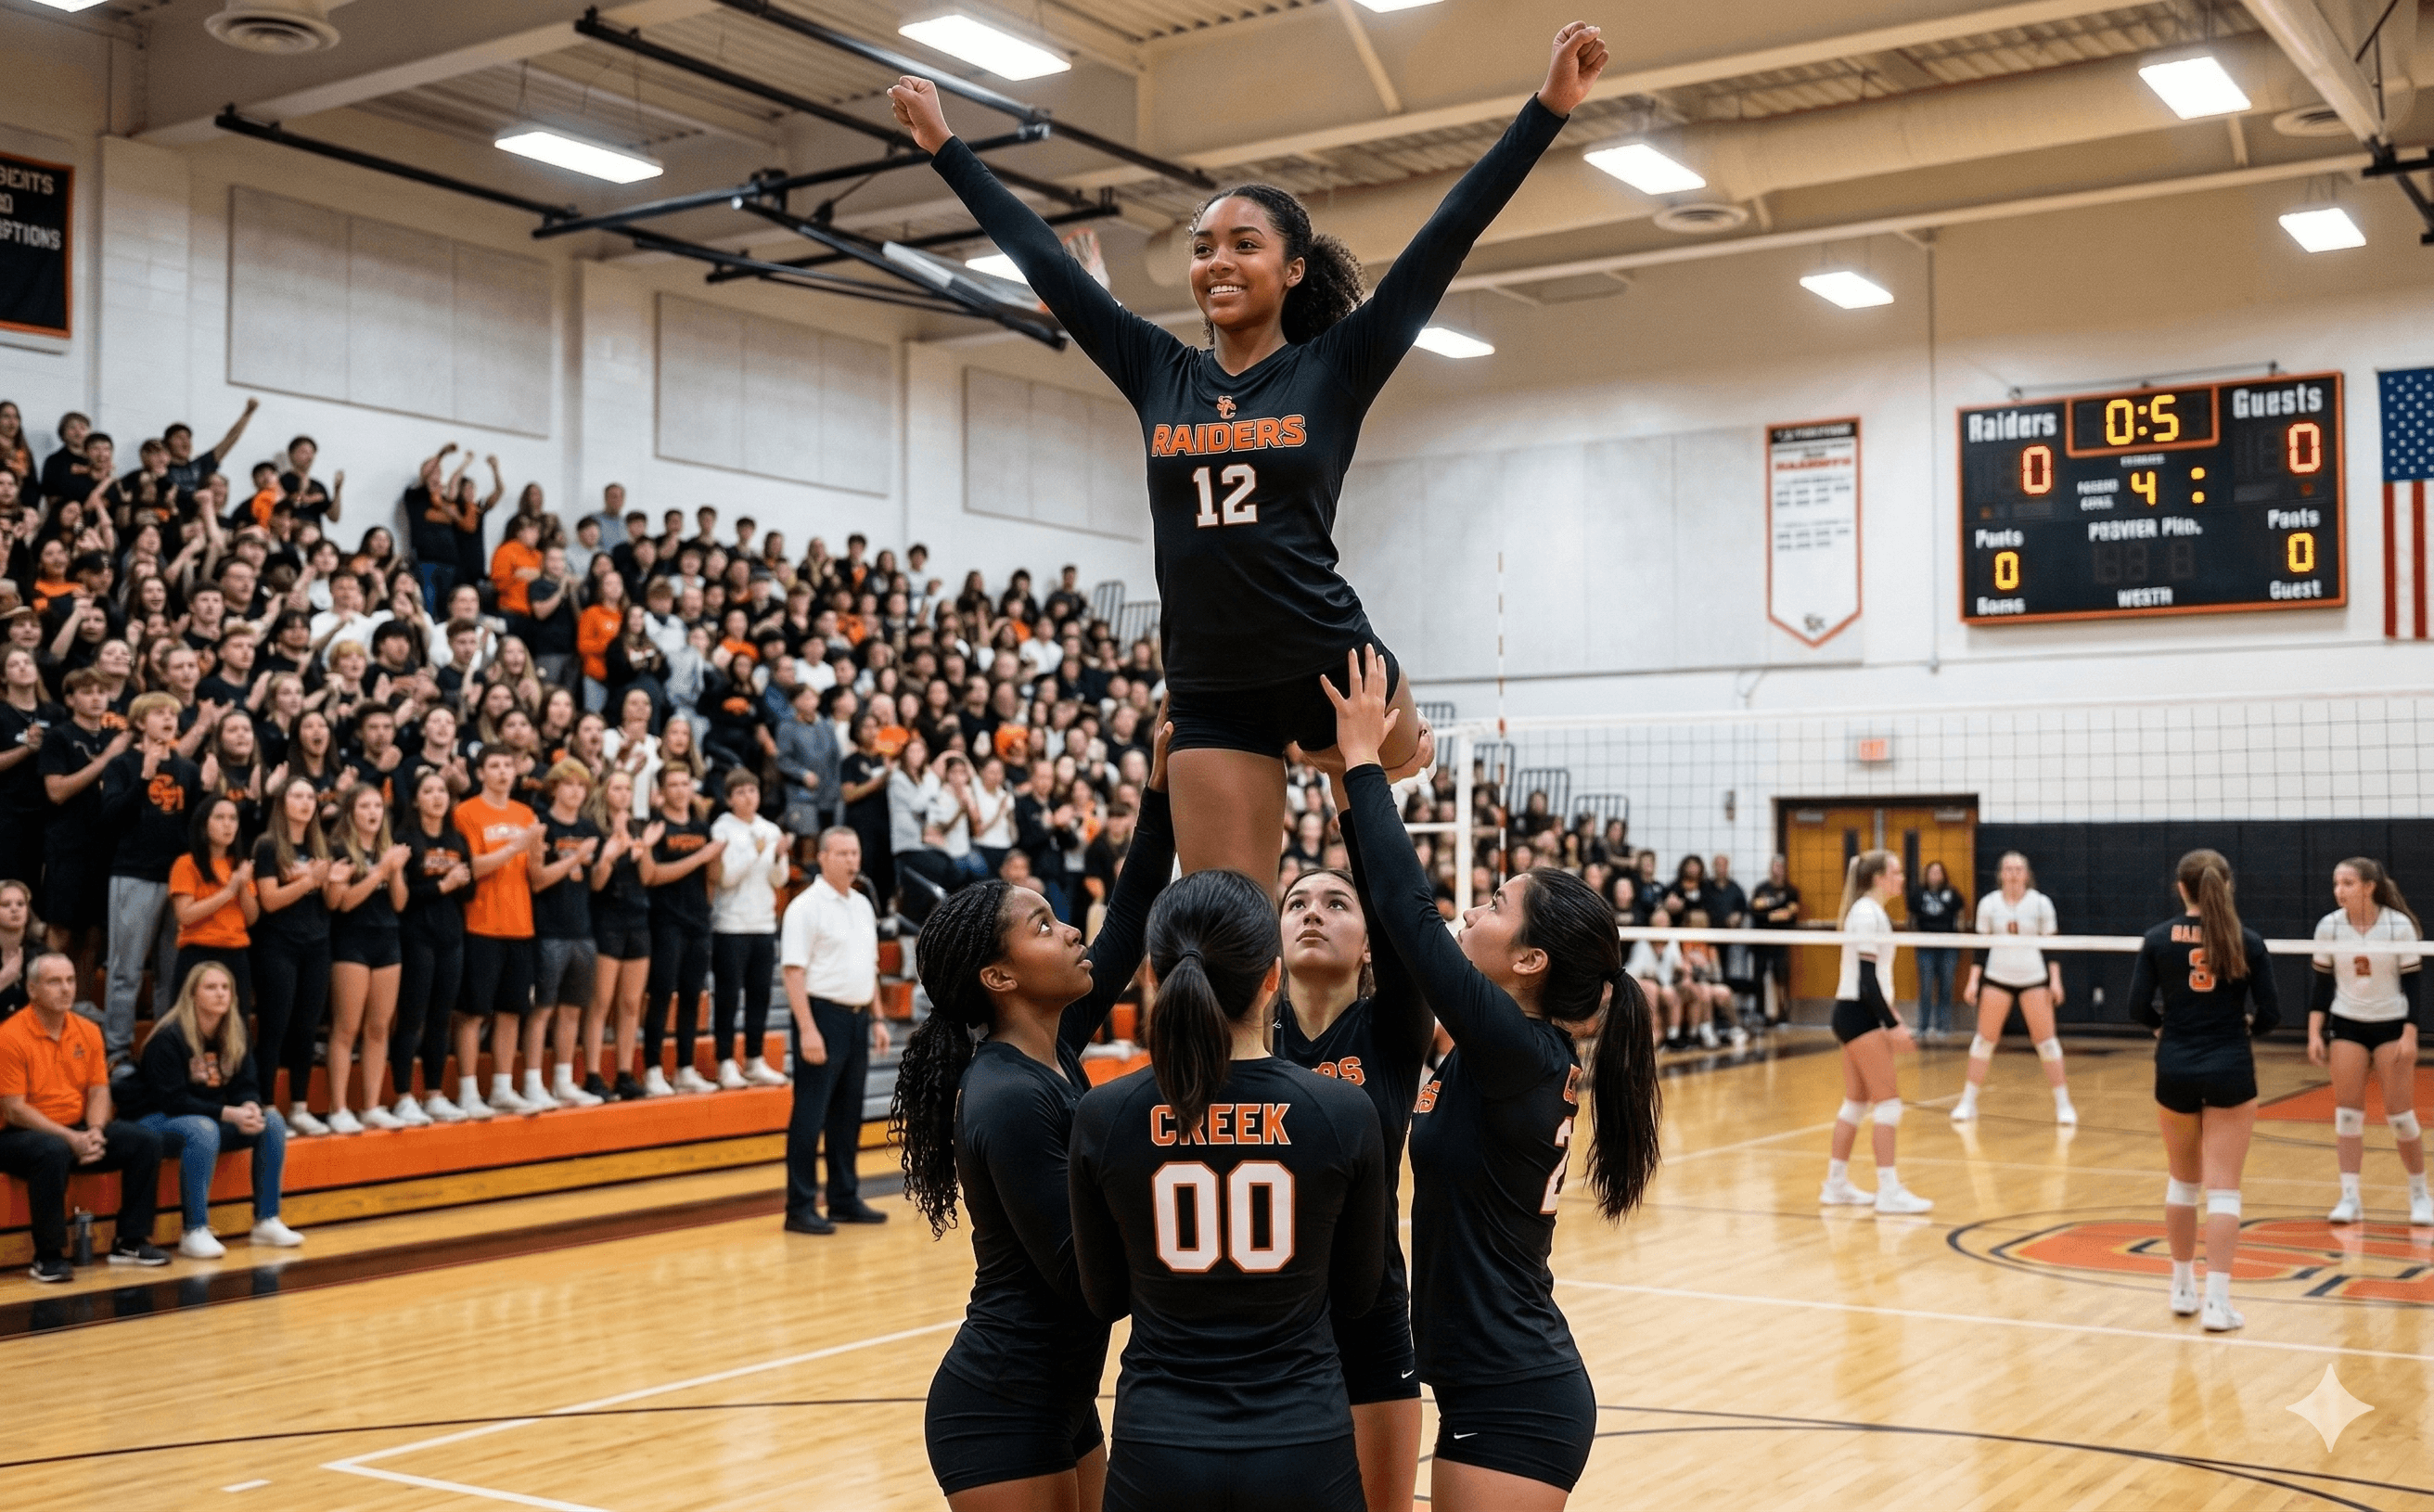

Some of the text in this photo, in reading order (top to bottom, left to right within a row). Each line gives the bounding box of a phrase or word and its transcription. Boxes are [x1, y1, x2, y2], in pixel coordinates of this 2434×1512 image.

[2232, 383, 2323, 419] Guests
[1151, 415, 1307, 457] RAIDERS
[1967, 410, 2057, 442] Raiders
[2287, 422, 2321, 474] 0
[2021, 444, 2053, 495] 0
[2131, 471, 2157, 506] 4
[1192, 463, 1259, 529] 12
[1994, 551, 2020, 591] 0
[2287, 532, 2315, 572] 0
[1150, 1103, 1292, 1147] CREEK
[1151, 1160, 1296, 1273] 00
